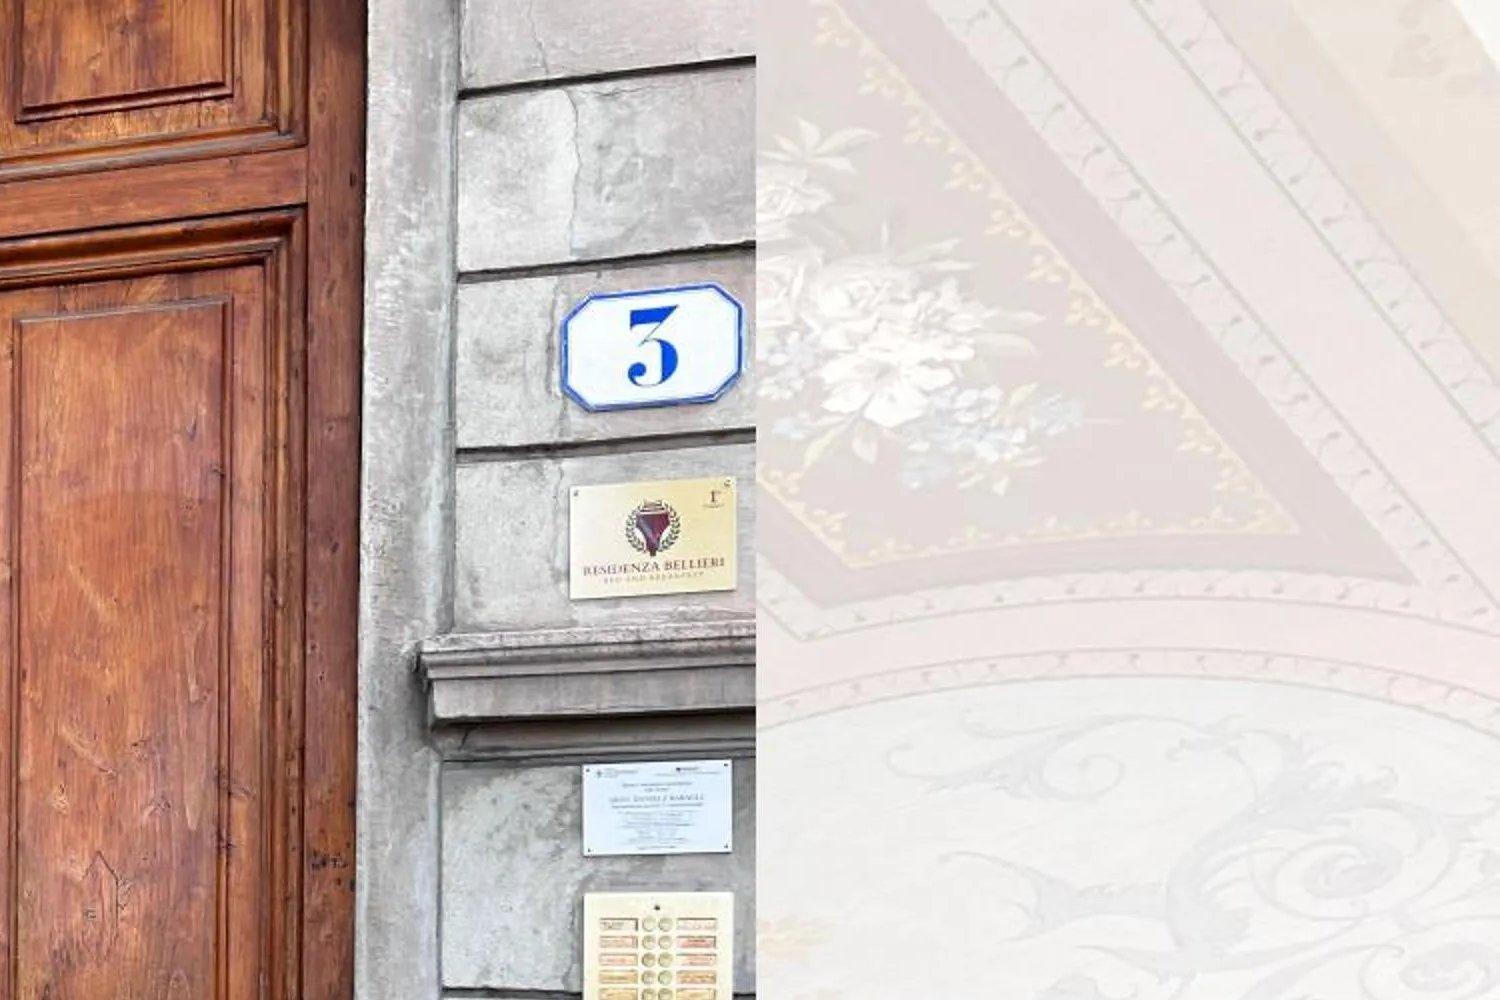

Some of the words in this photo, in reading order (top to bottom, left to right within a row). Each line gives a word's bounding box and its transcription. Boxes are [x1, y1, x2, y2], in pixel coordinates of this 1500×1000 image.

[628, 304, 679, 387] 3
[583, 561, 660, 576] RESIDENZA
[664, 557, 725, 571] BELLIERI
